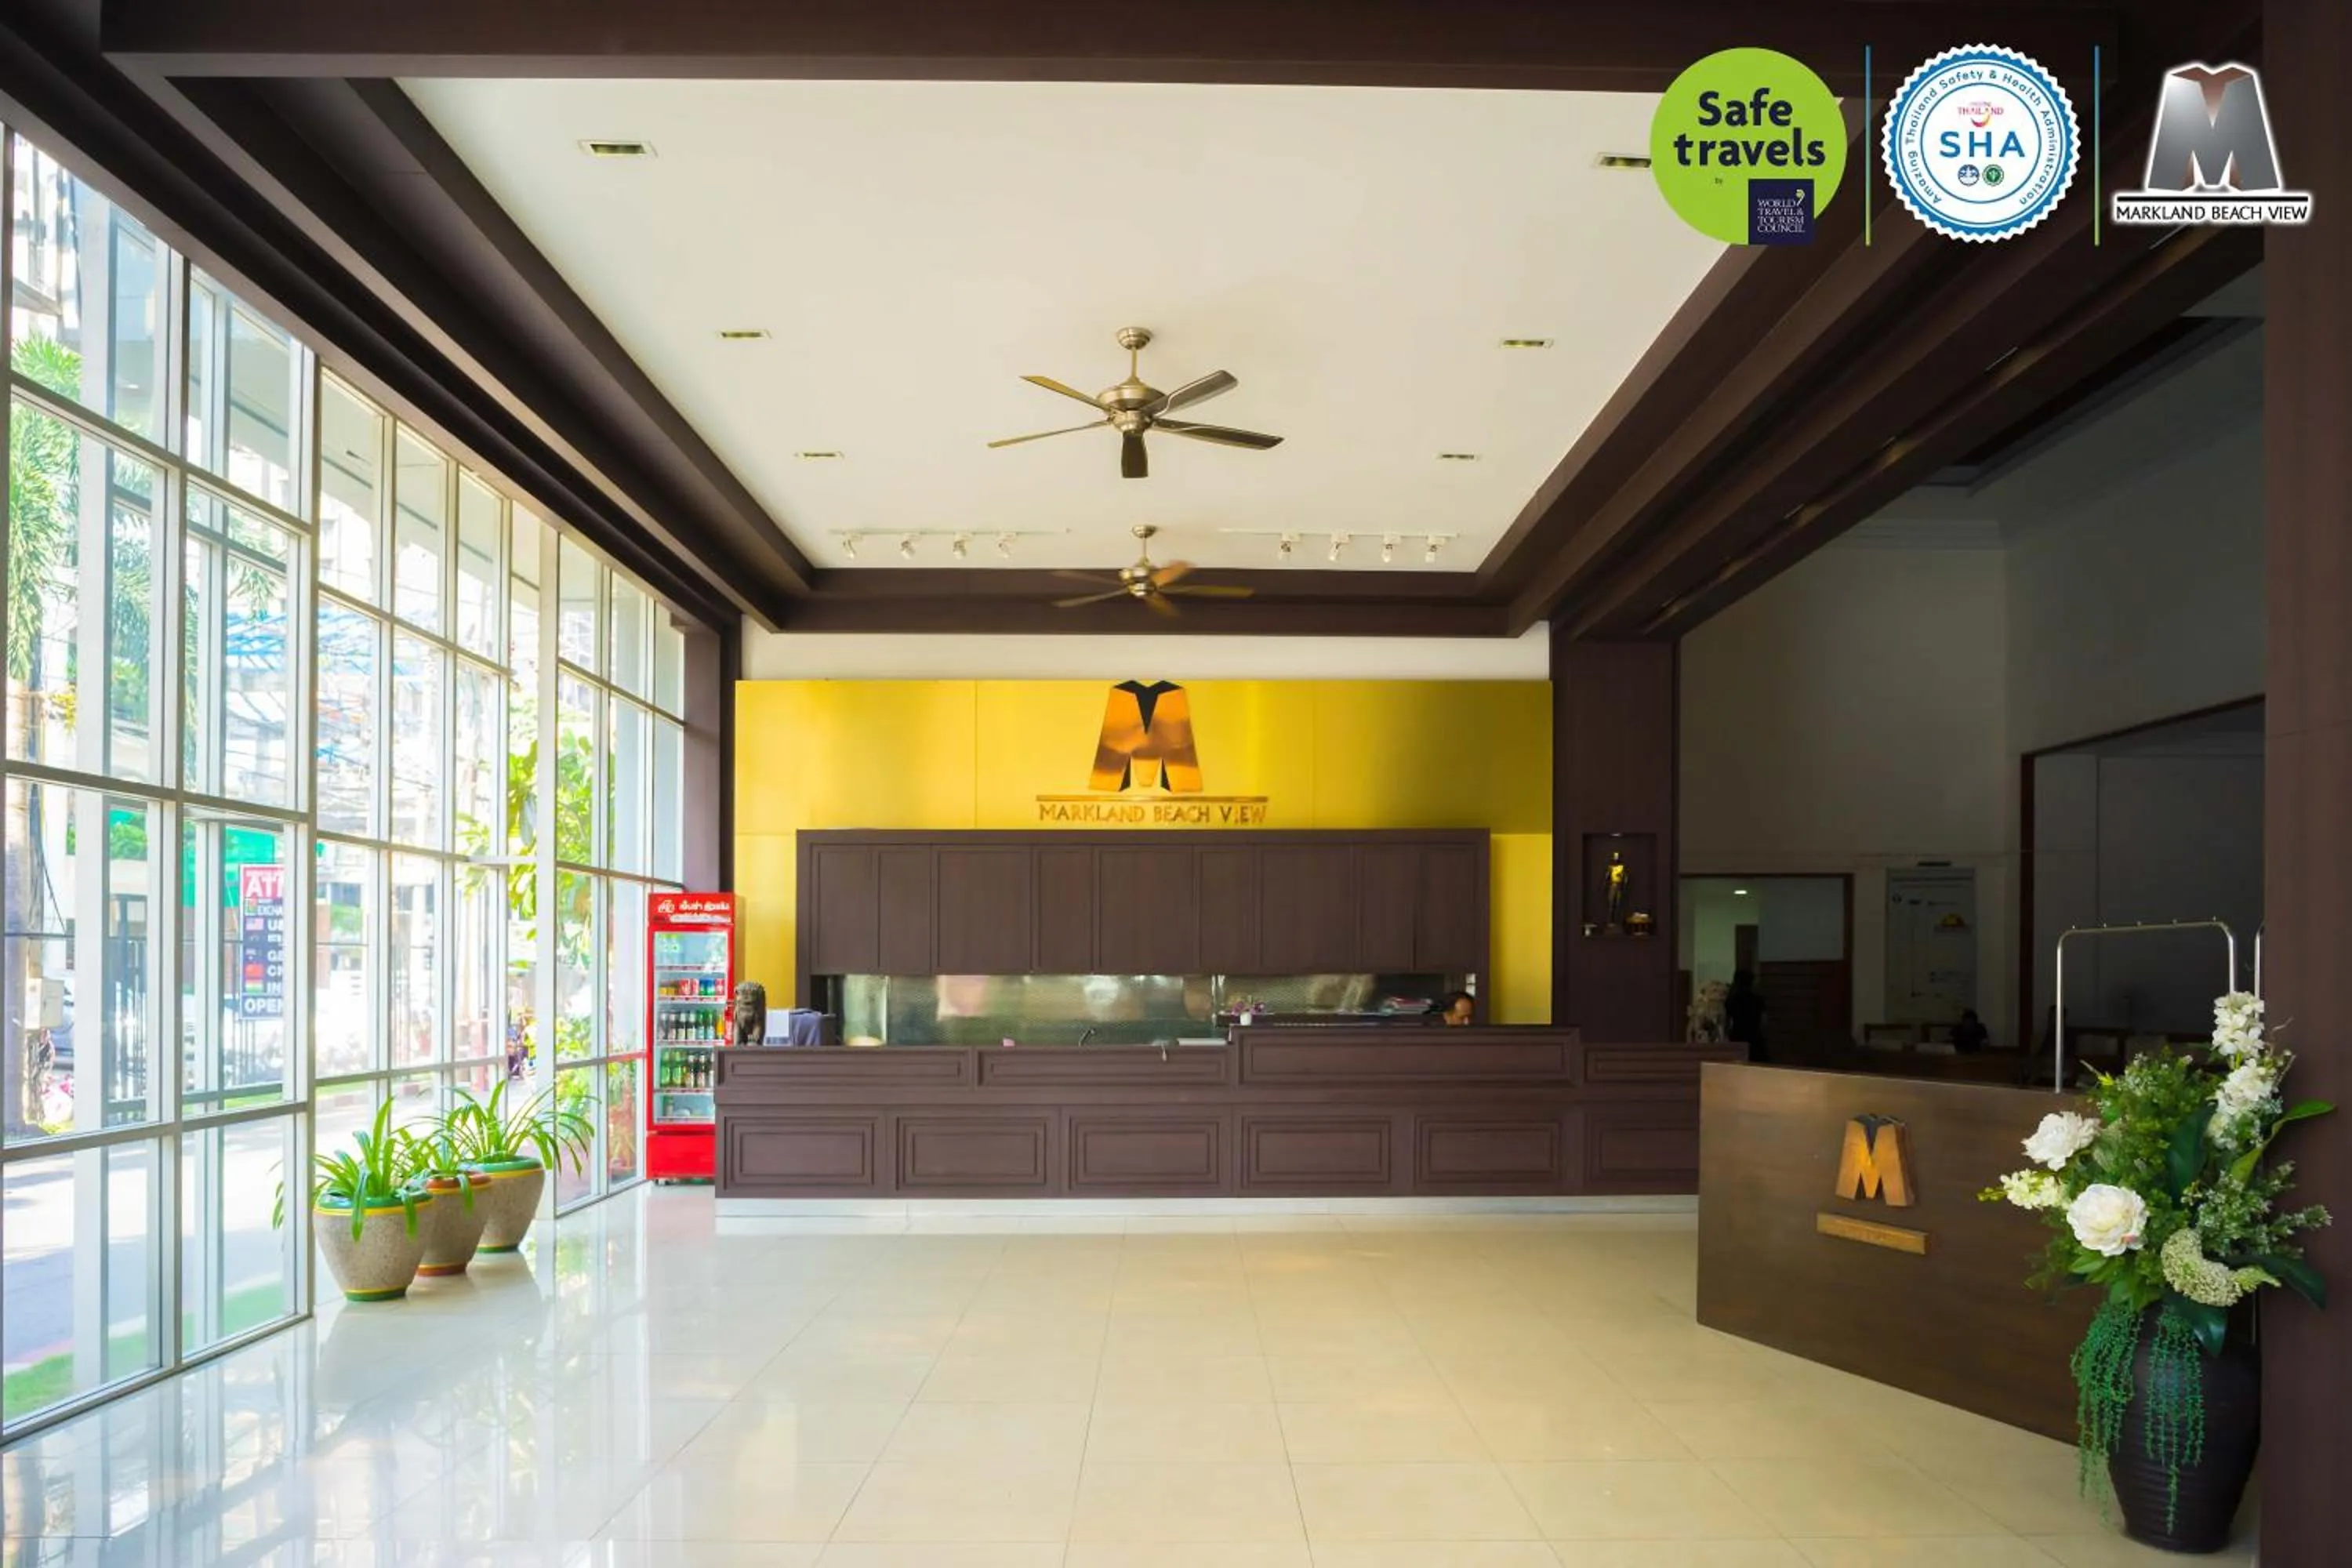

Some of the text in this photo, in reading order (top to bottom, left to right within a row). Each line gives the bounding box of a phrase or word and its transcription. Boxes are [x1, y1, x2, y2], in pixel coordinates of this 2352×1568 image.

[1039, 803, 1267, 824] MARKLAND BEACH VIEW
